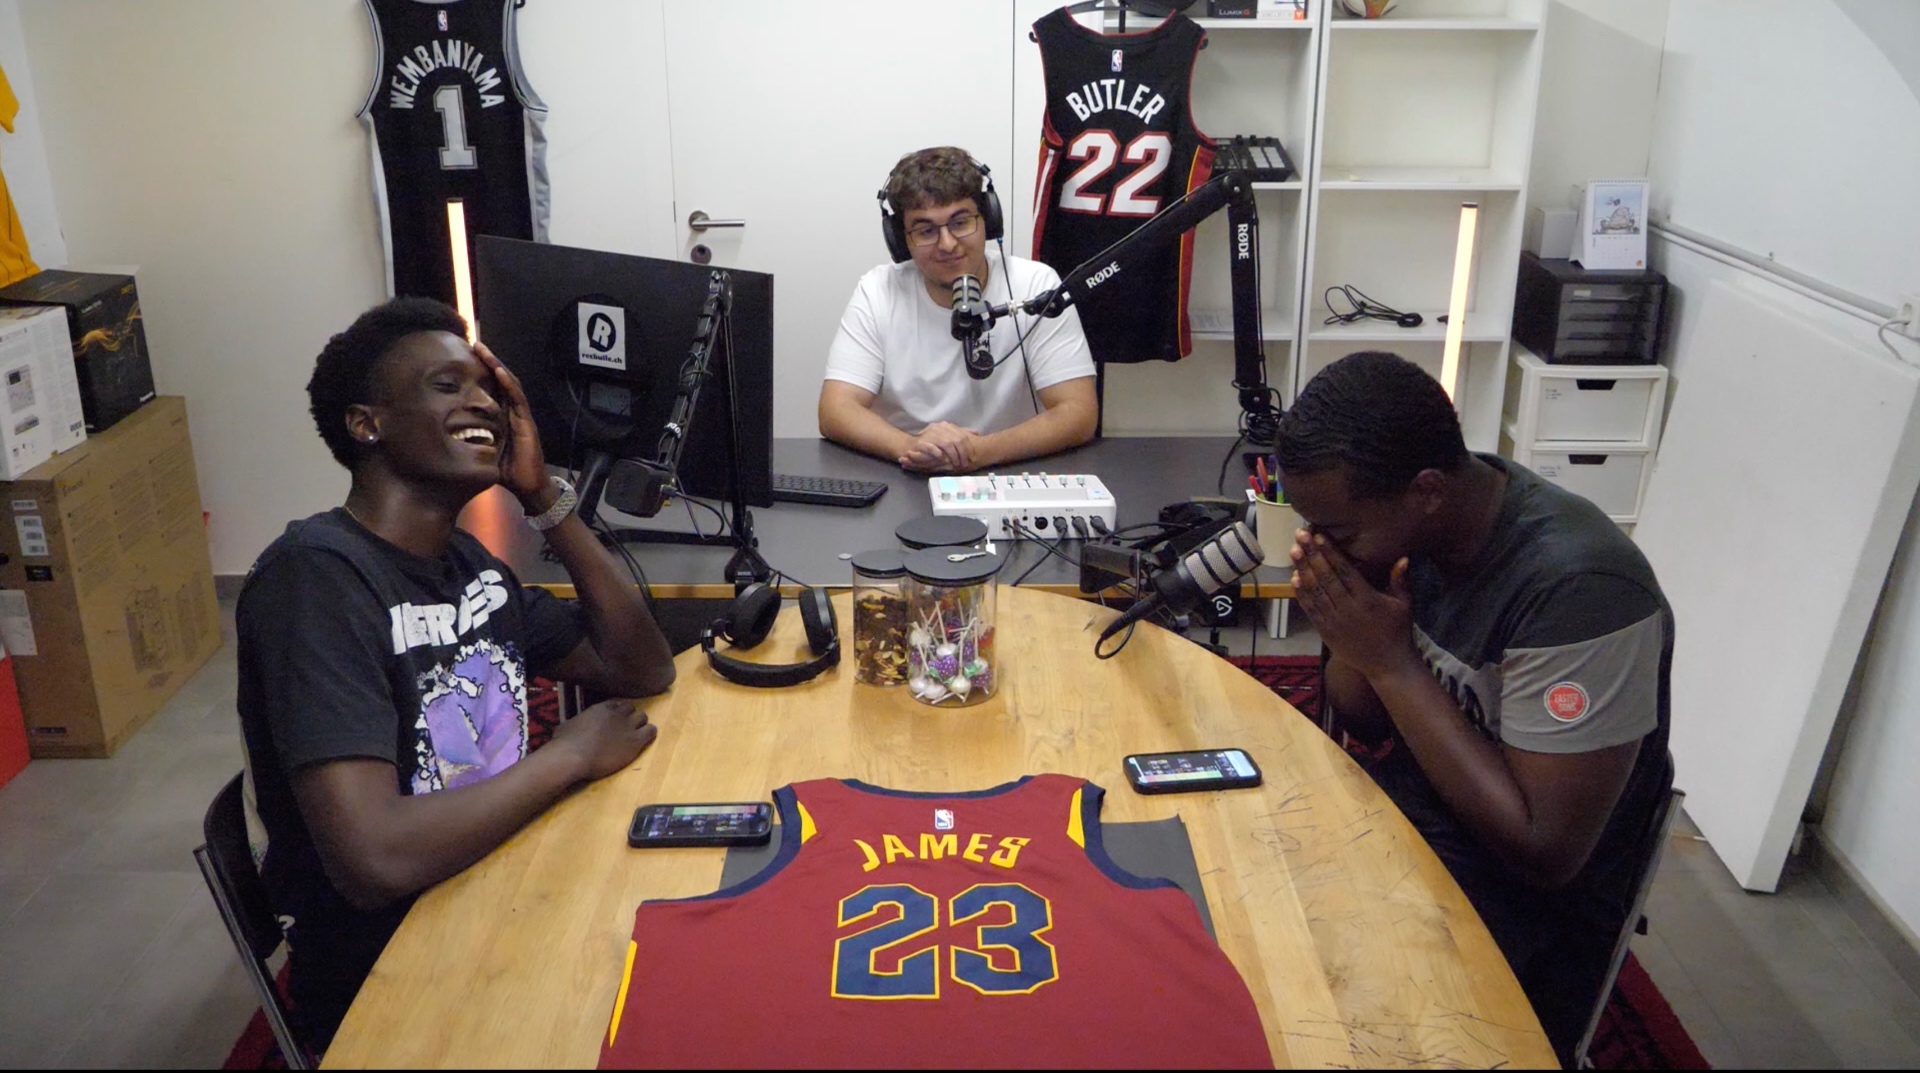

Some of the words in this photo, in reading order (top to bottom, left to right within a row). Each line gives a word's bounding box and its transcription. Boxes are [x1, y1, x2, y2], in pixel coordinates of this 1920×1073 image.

[390, 39, 505, 109] WEMBANYAMA
[1065, 78, 1166, 125] BUTLER
[433, 84, 478, 170] 1
[1058, 128, 1173, 218] 22
[591, 317, 612, 349] R
[853, 833, 1031, 873] JAMES
[831, 882, 1059, 999] 23
